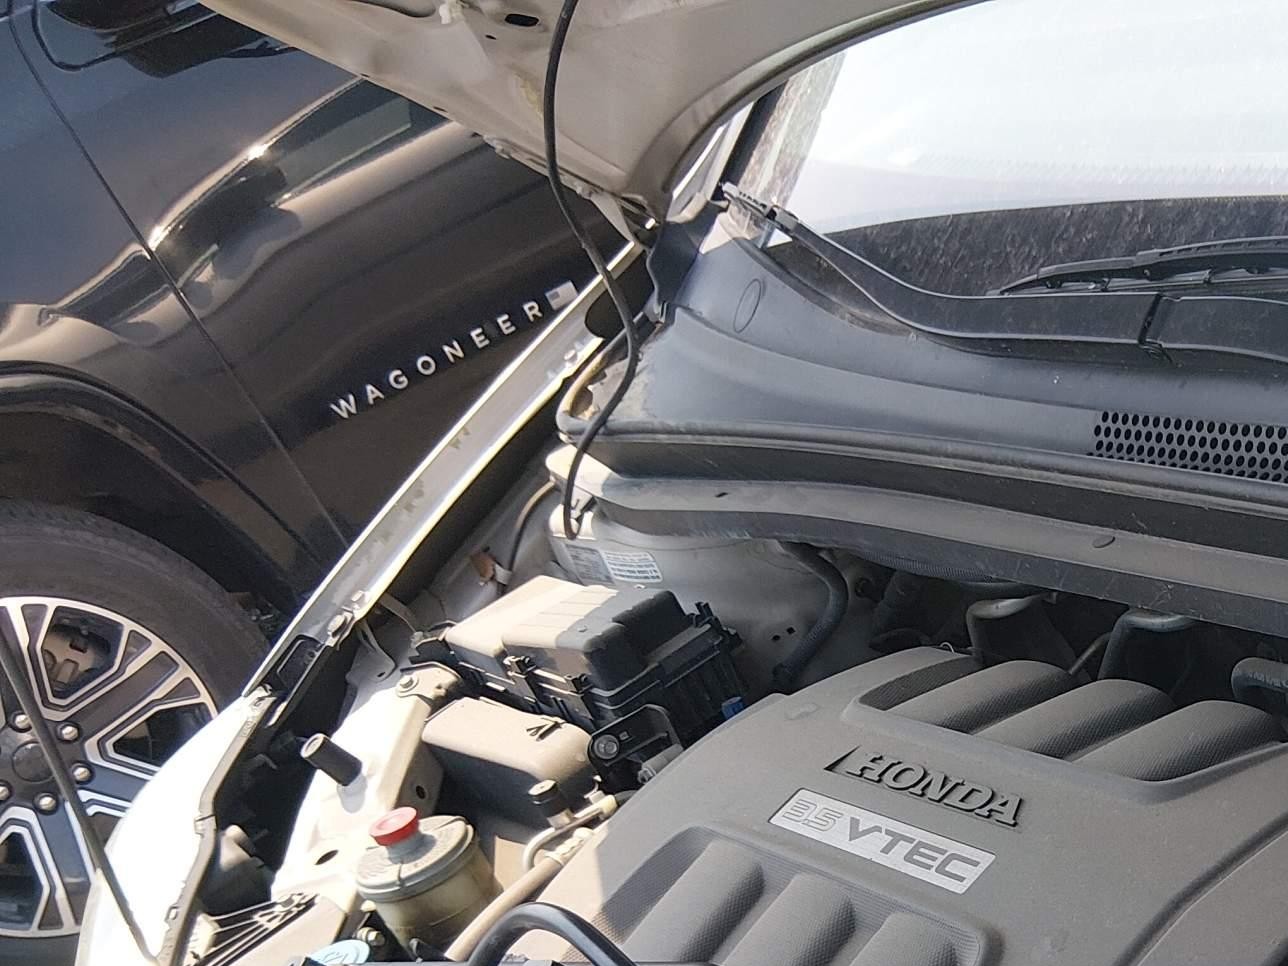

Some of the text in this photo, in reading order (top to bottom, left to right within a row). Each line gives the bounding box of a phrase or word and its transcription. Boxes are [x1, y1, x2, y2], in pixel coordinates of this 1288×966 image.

[329, 300, 543, 419] WAGONEER
[846, 752, 1024, 828] HONDA
[849, 816, 981, 884] VTEC
